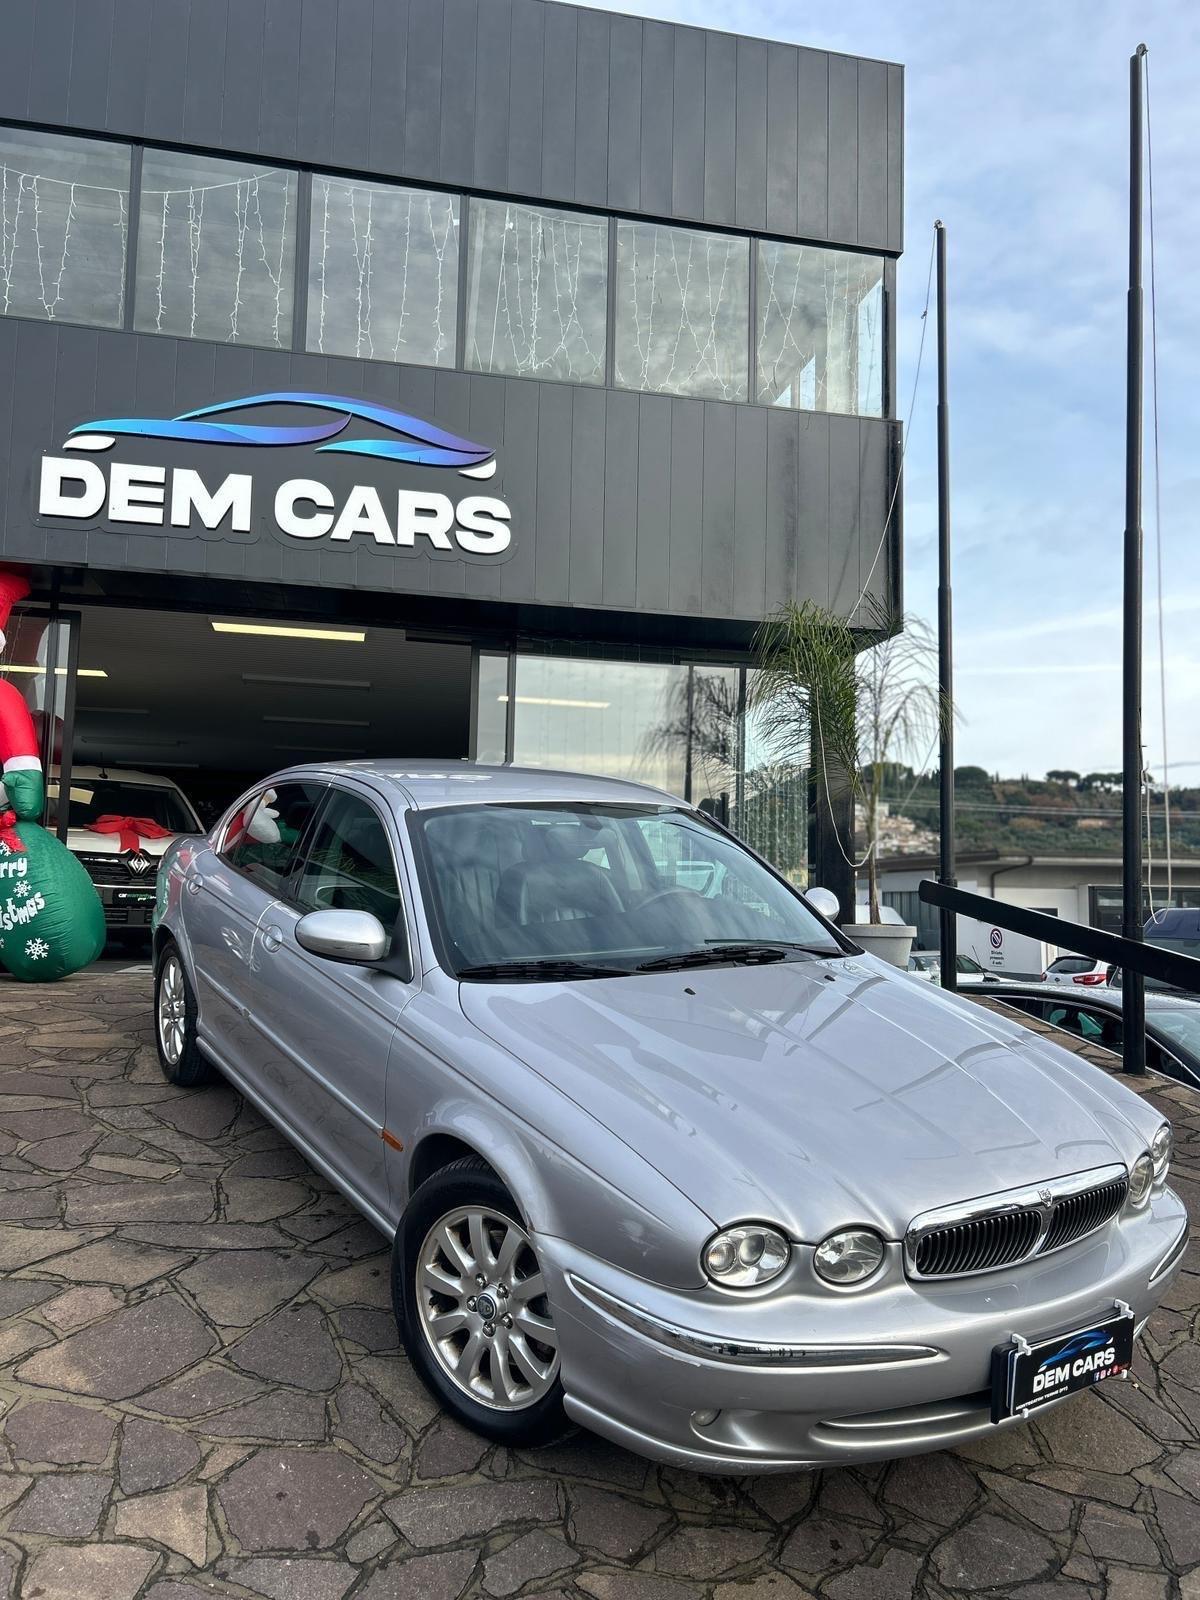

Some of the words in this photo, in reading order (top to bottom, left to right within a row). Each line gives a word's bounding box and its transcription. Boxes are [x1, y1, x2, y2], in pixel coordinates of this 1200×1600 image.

[39, 456, 252, 532] DEM
[274, 478, 511, 553] CARS
[1032, 1363, 1070, 1394] DEM
[1072, 1347, 1116, 1377] CARS
